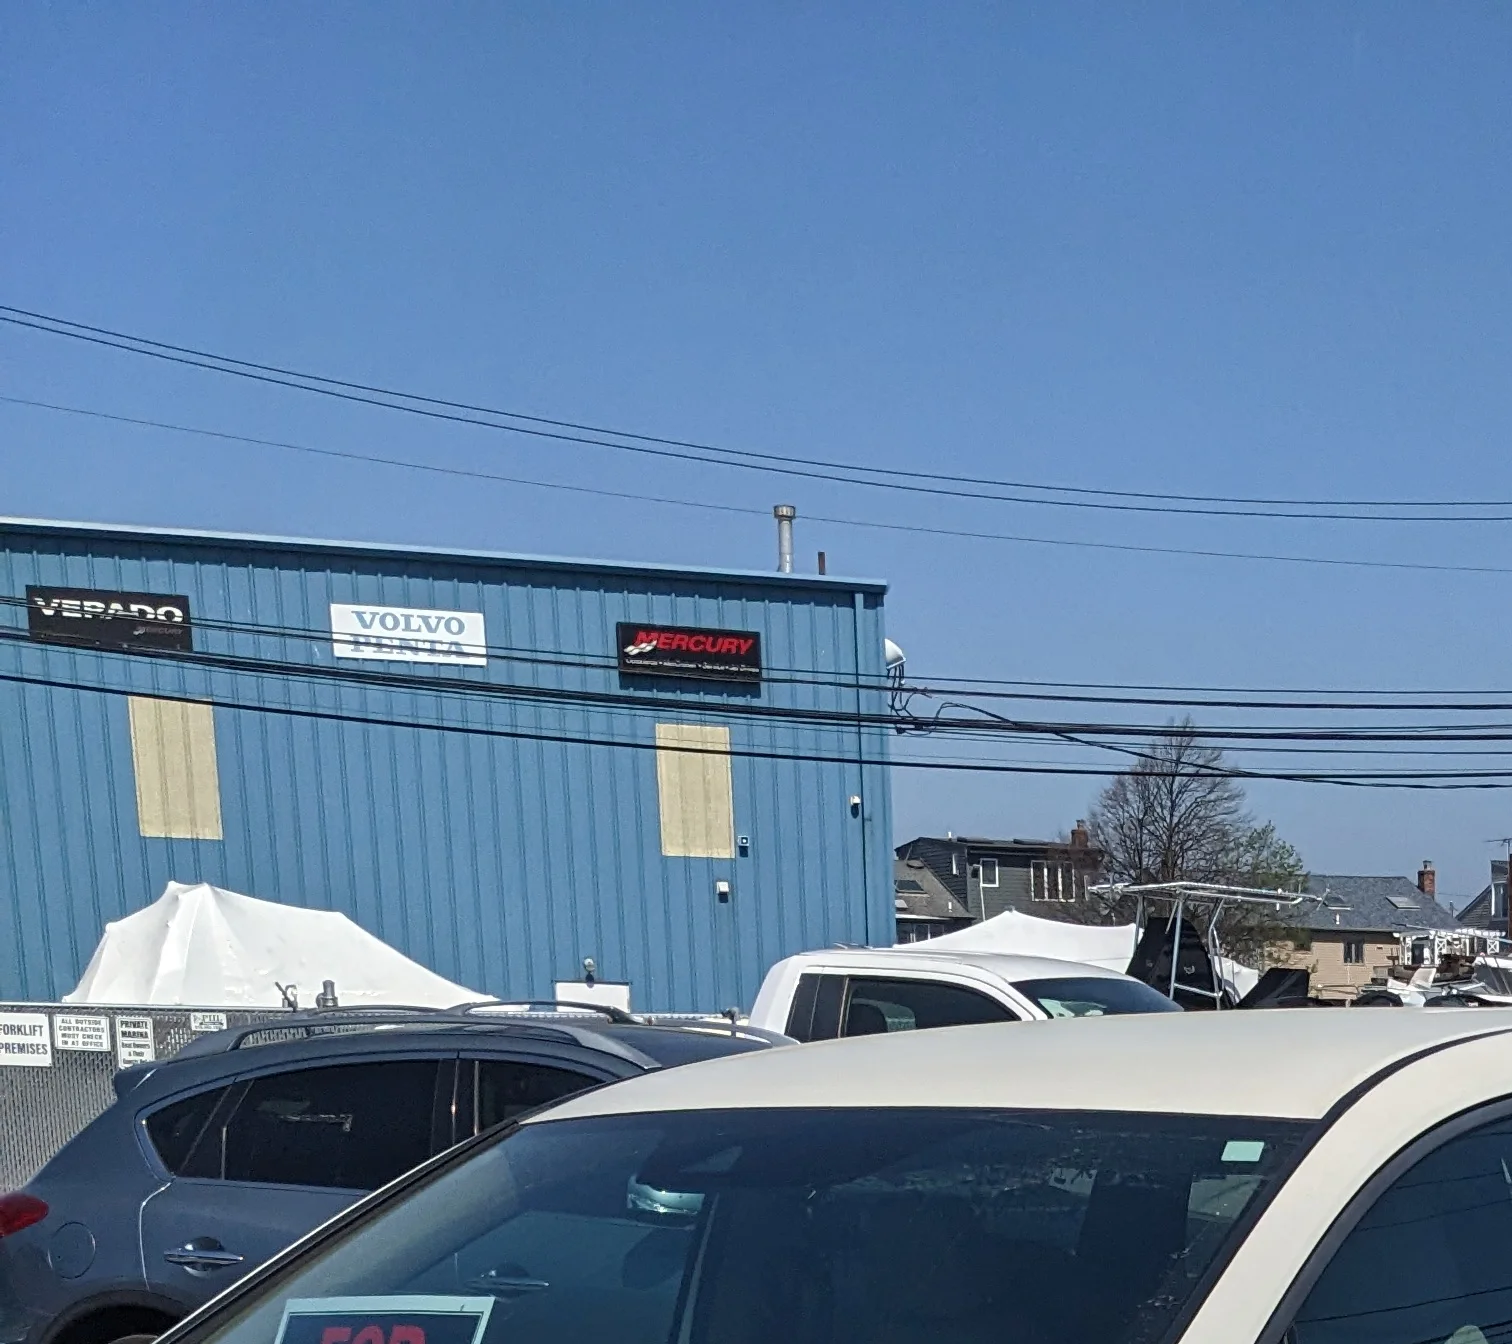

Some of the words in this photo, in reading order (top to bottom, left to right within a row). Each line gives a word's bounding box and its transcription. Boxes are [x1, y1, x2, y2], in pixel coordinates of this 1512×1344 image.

[34, 597, 183, 622] VERADO
[351, 611, 466, 636] VOLVO
[350, 635, 475, 658] PENTA
[633, 631, 754, 655] MERCURY
[120, 1020, 148, 1029] PRIVATE
[0, 1042, 48, 1055] PREMISES
